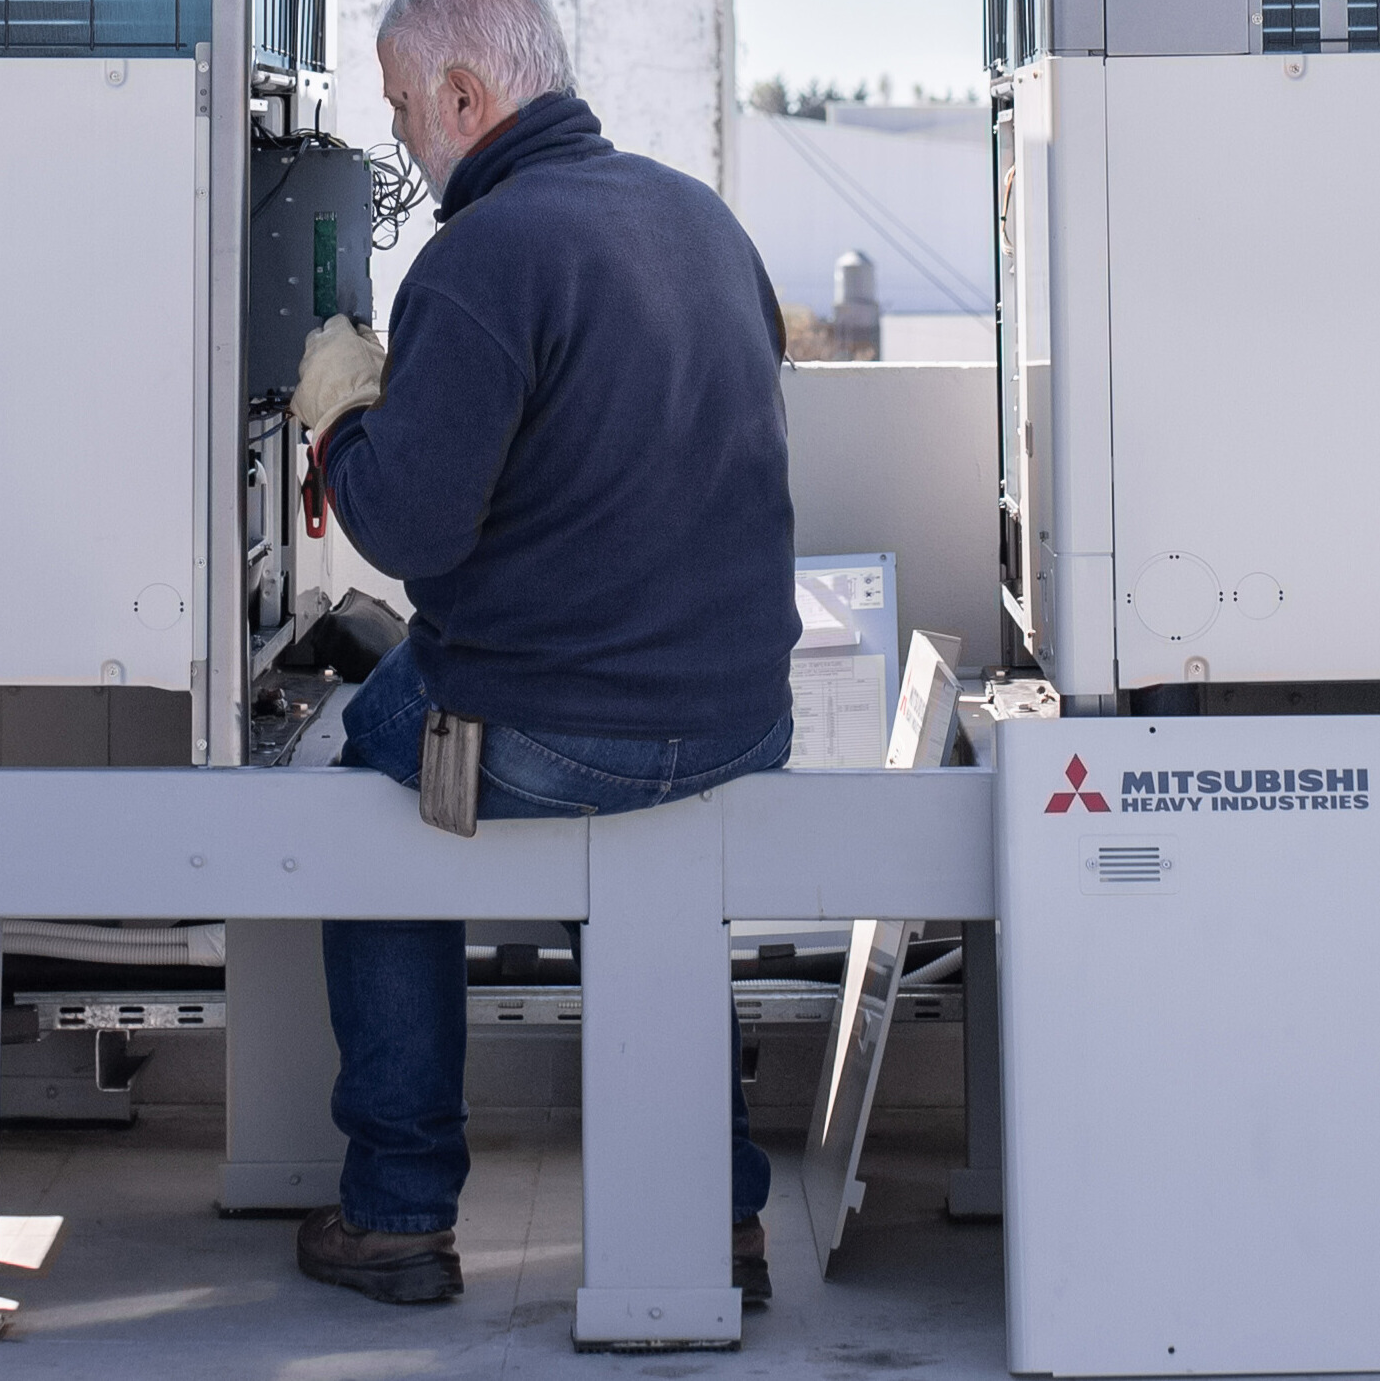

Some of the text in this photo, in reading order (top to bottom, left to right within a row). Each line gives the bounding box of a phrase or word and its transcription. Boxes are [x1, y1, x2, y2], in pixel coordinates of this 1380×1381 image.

[1122, 769, 1369, 794] MITSUBISHI
[1122, 794, 1369, 812] HEAVY INDUSTRIES
